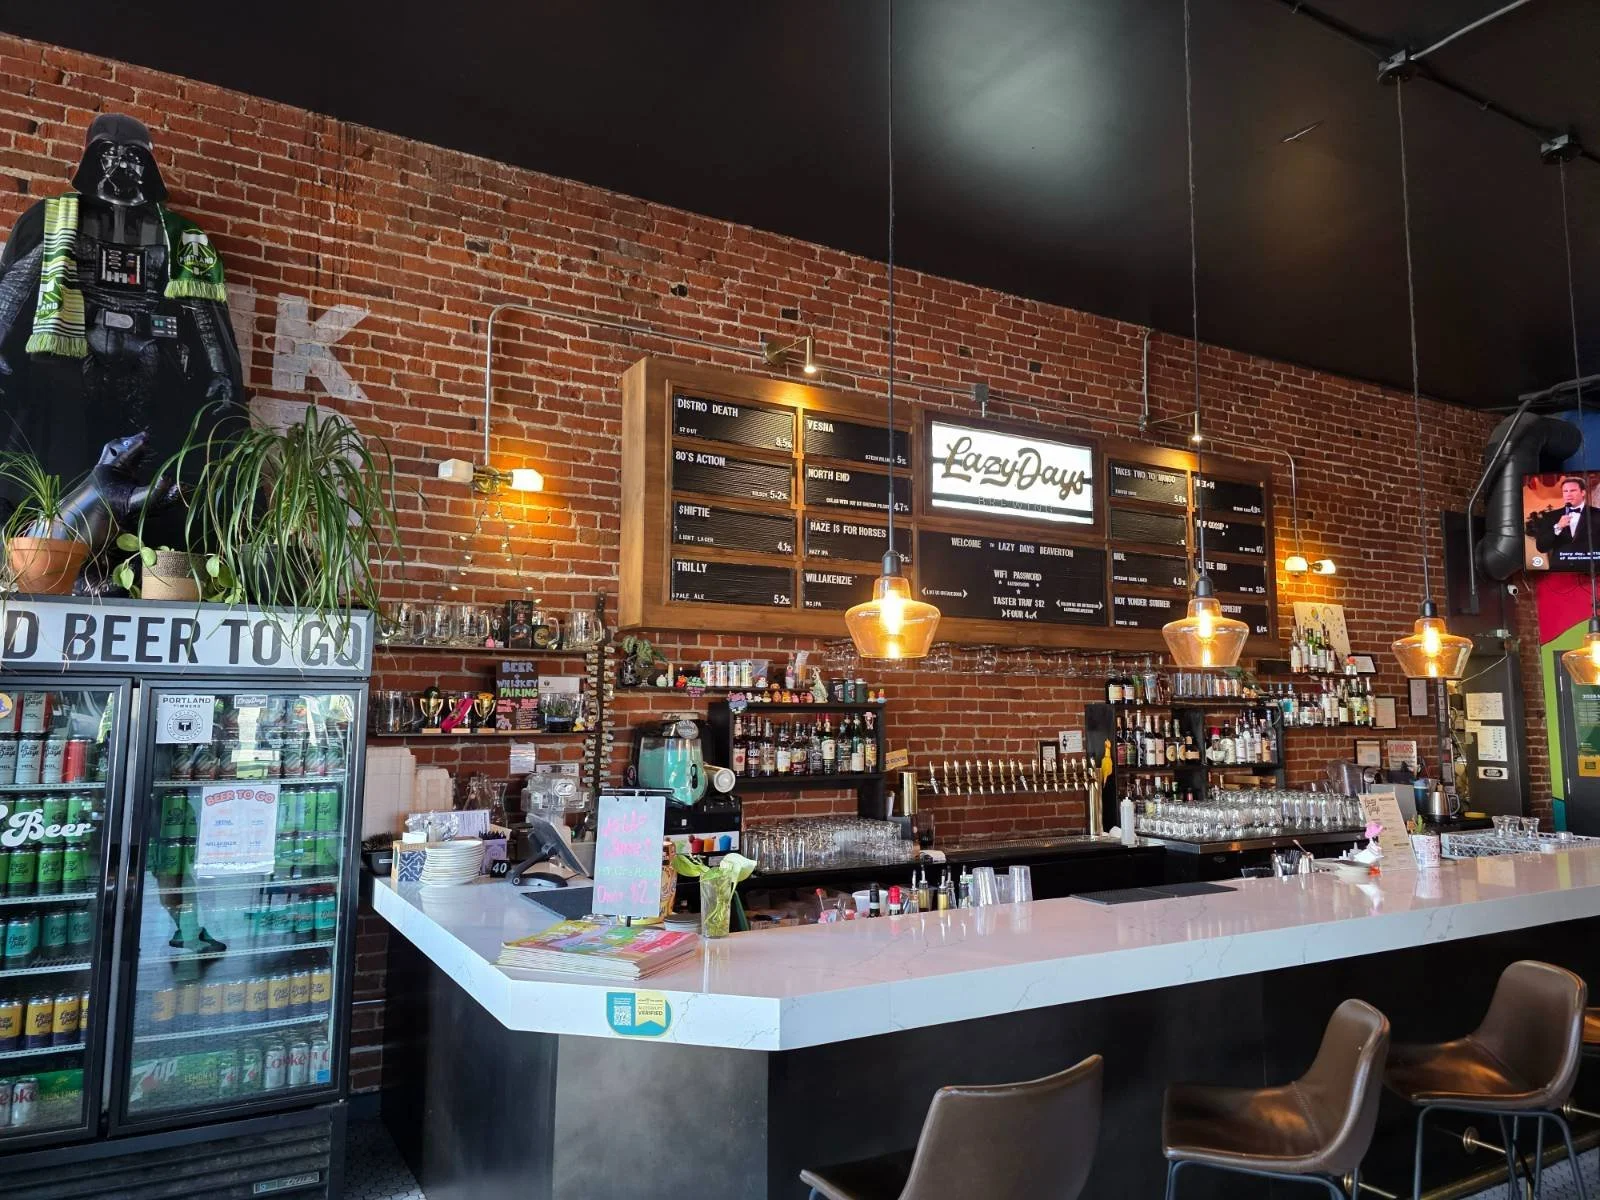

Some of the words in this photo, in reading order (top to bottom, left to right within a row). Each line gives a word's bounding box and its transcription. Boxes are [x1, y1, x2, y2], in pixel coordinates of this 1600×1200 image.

[712, 404, 739, 417] DEATH
[696, 453, 726, 467] ACTION
[808, 468, 834, 481] NORTH
[835, 471, 850, 482] END
[1114, 467, 1131, 477] TAKES
[1133, 469, 1146, 479] TWO
[1147, 472, 1155, 480] TO
[810, 521, 831, 533] HAZE
[843, 525, 858, 536] FOR
[858, 526, 887, 538] HORSES
[951, 537, 982, 549] WELCOME
[998, 542, 1015, 552] LAZY
[1019, 544, 1035, 554] DAYS
[1040, 546, 1074, 558] BEAVERTON
[676, 561, 708, 573] TRILLY
[805, 572, 853, 585] WILLAKENZIE
[993, 569, 1008, 579] WIFI
[993, 596, 1017, 606] TASTER
[1017, 598, 1033, 607] TRAY
[1006, 609, 1024, 619] FOUR
[62, 611, 202, 664] BEER
[221, 618, 283, 667] TO
[300, 619, 362, 668] GO
[502, 661, 534, 673] BEER
[496, 679, 538, 688] WHISKEY
[500, 687, 538, 698] PAIRING
[205, 790, 235, 806] BEER
[236, 789, 255, 800] TO
[255, 790, 276, 804] GO
[1, 808, 97, 847] Beer
[492, 862, 508, 874] 40
